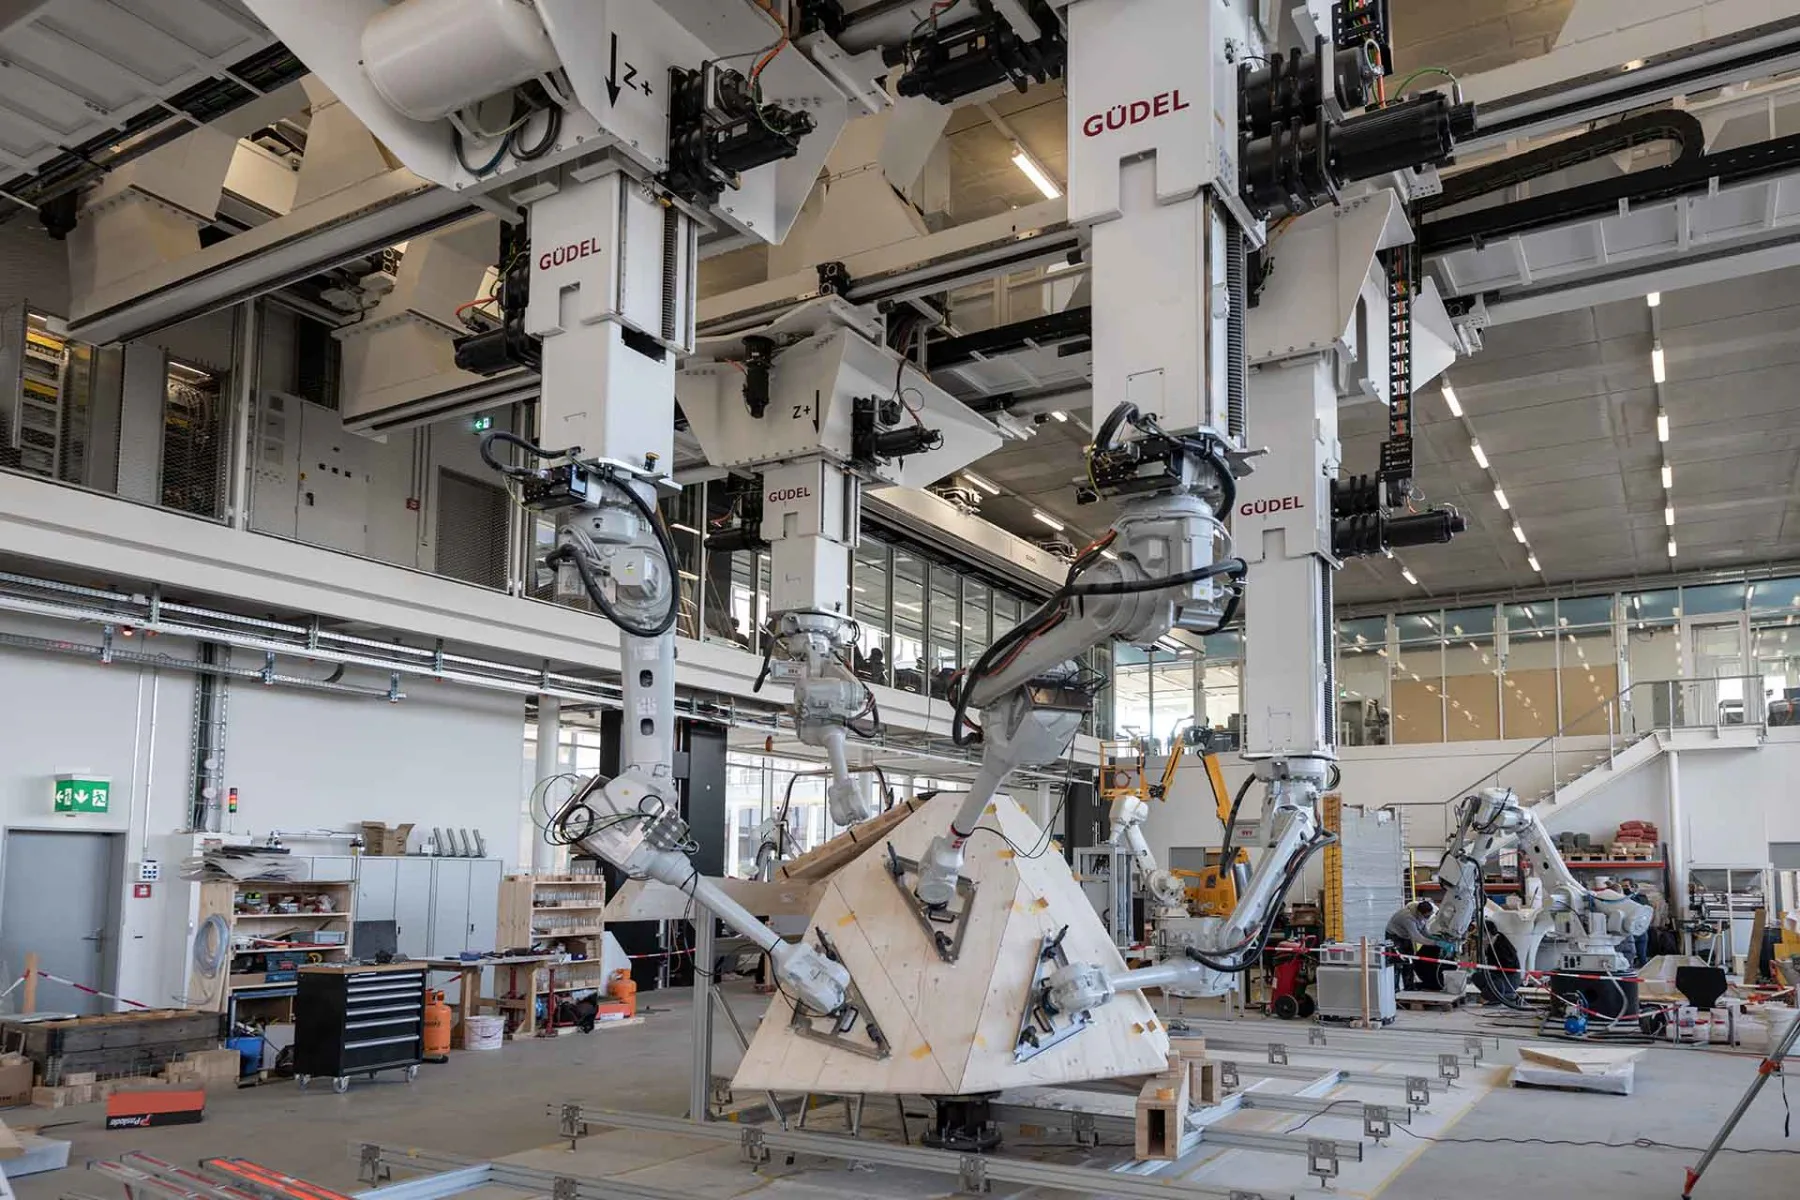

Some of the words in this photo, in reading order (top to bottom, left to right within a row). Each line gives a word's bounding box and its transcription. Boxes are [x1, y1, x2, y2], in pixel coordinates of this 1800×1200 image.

[623, 61, 653, 97] Z+
[1082, 89, 1190, 137] GÜDEL
[539, 236, 602, 271] GÜDEL
[792, 404, 811, 419] Z+
[769, 486, 811, 503] GÜDEL
[1240, 496, 1305, 516] GÜDEL
